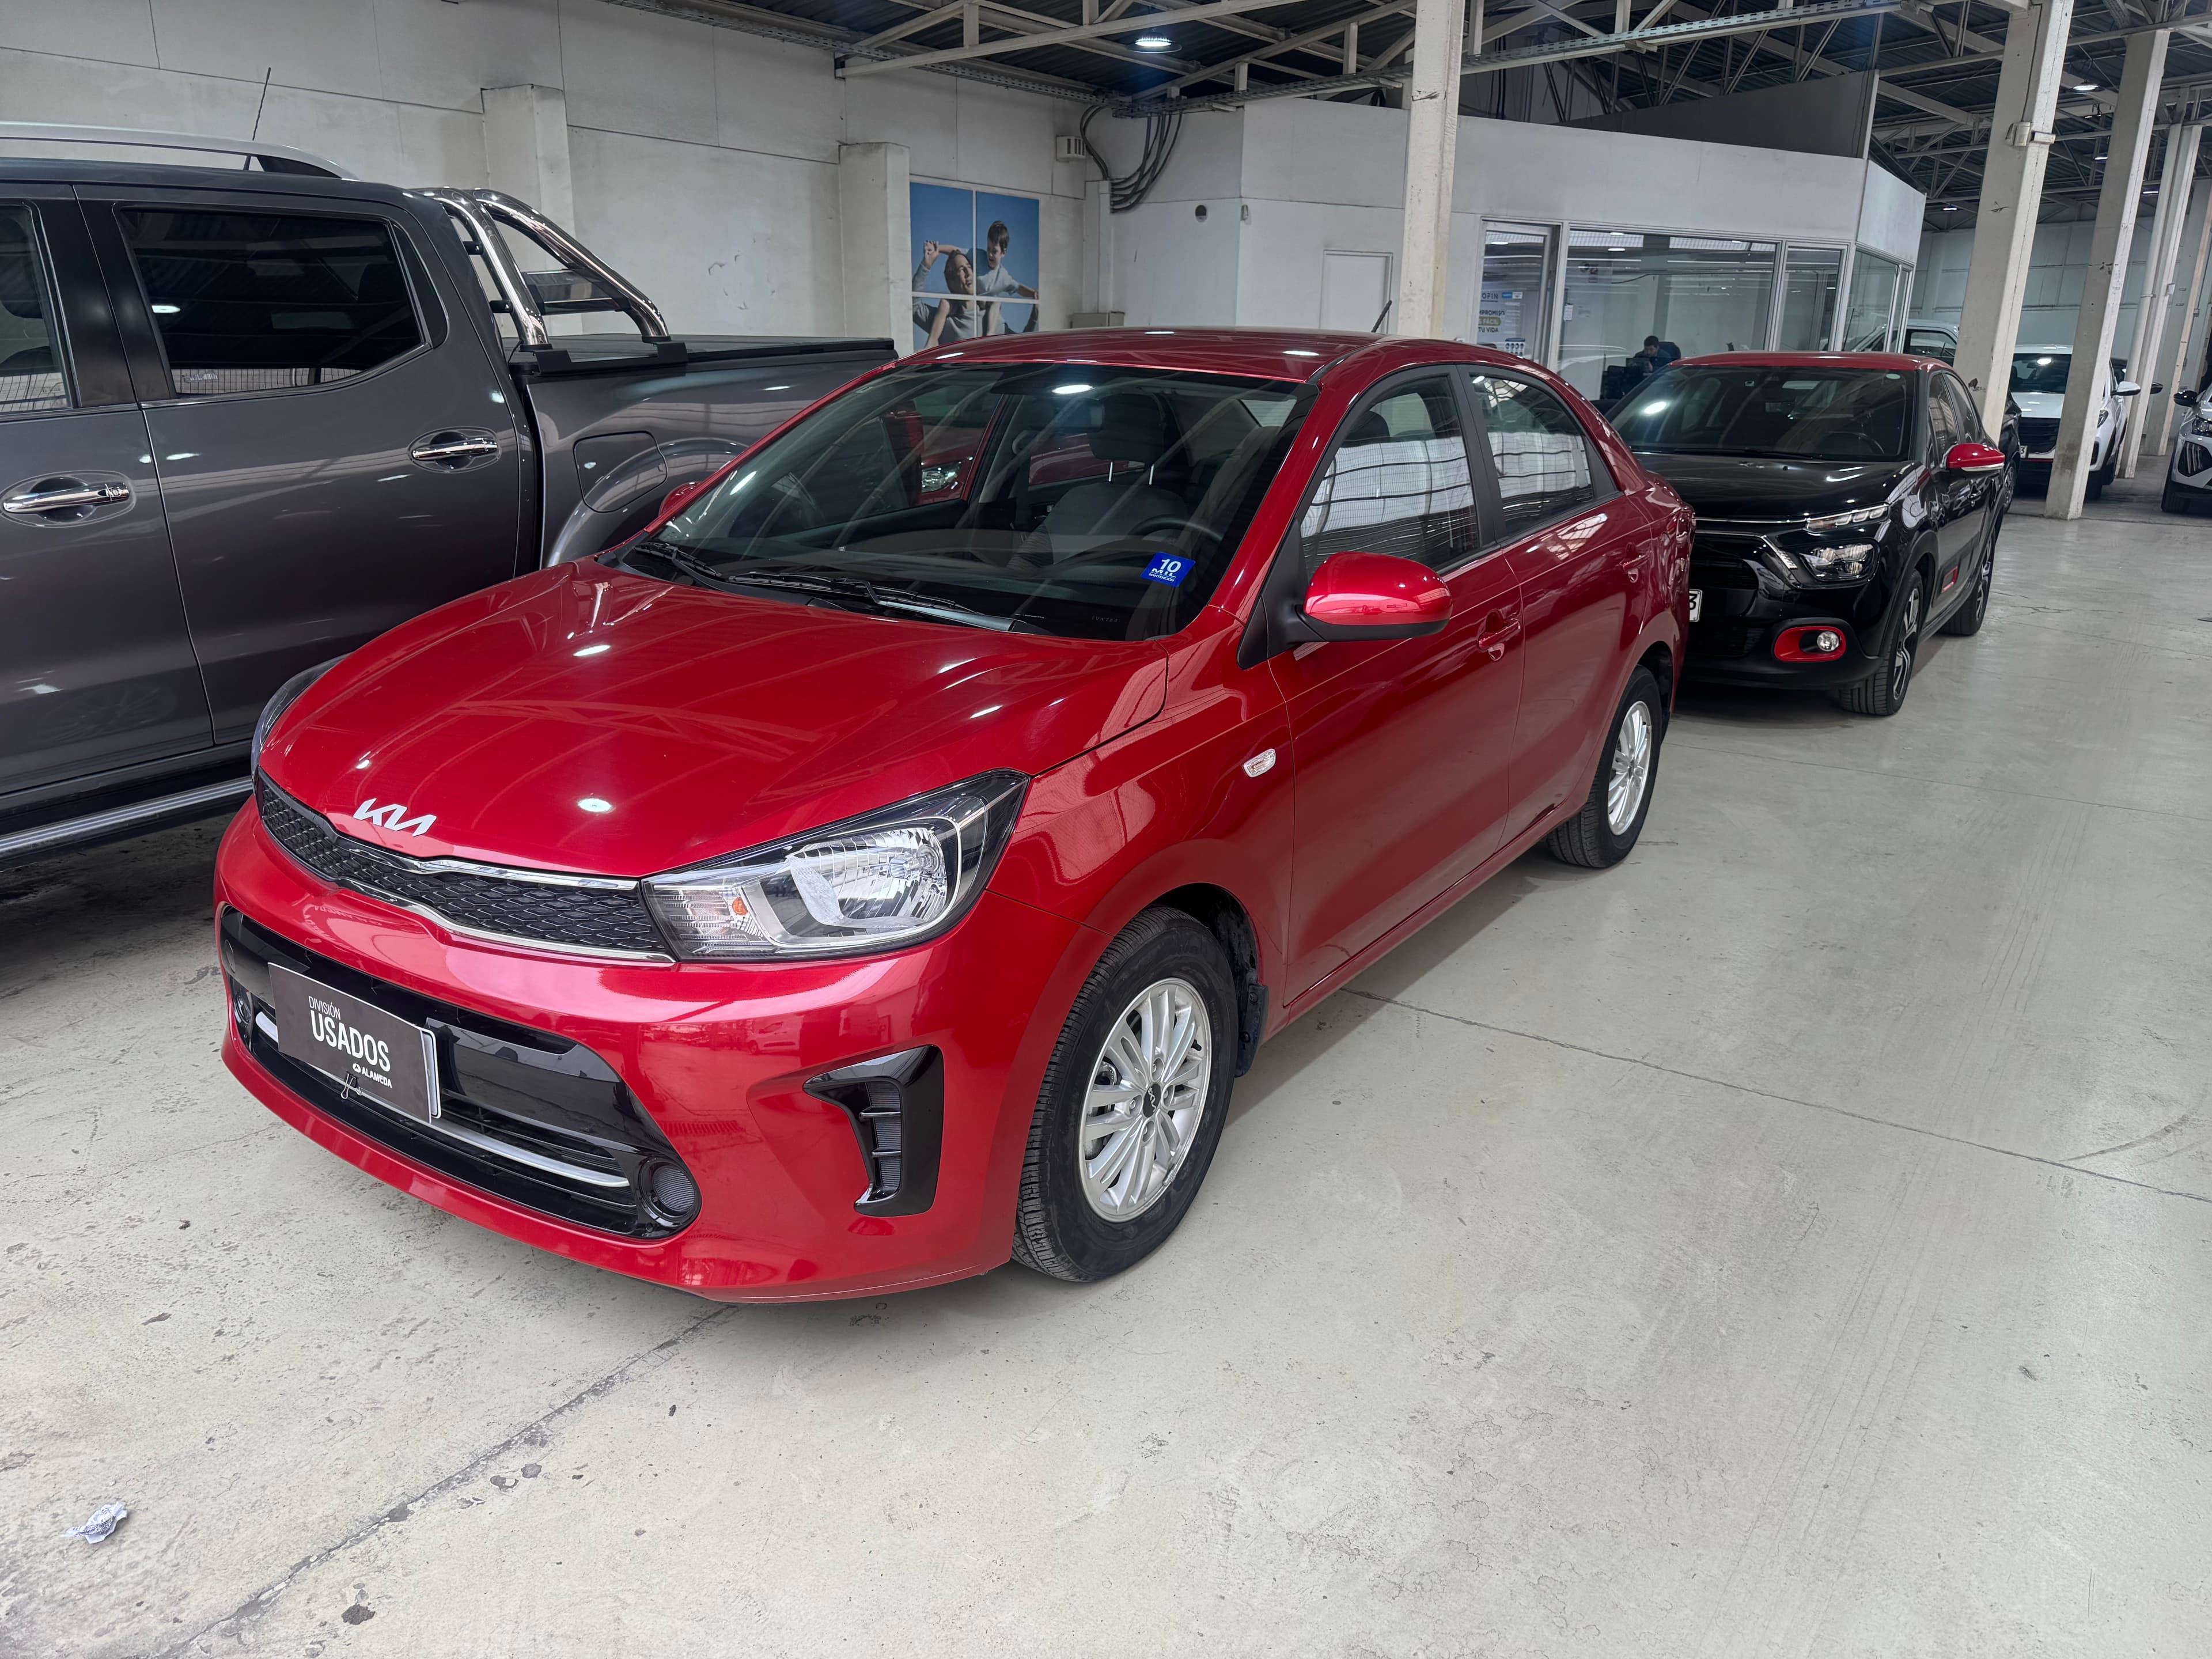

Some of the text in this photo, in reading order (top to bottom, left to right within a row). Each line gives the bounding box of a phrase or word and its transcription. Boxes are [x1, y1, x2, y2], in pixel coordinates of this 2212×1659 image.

[1152, 568, 1177, 578] MIL
[1160, 559, 1181, 573] 10
[353, 798, 437, 836] KIA
[308, 995, 341, 1020] DIVISIÓN
[310, 1010, 391, 1072] USADOS
[362, 1067, 392, 1089] ALAMEDA
